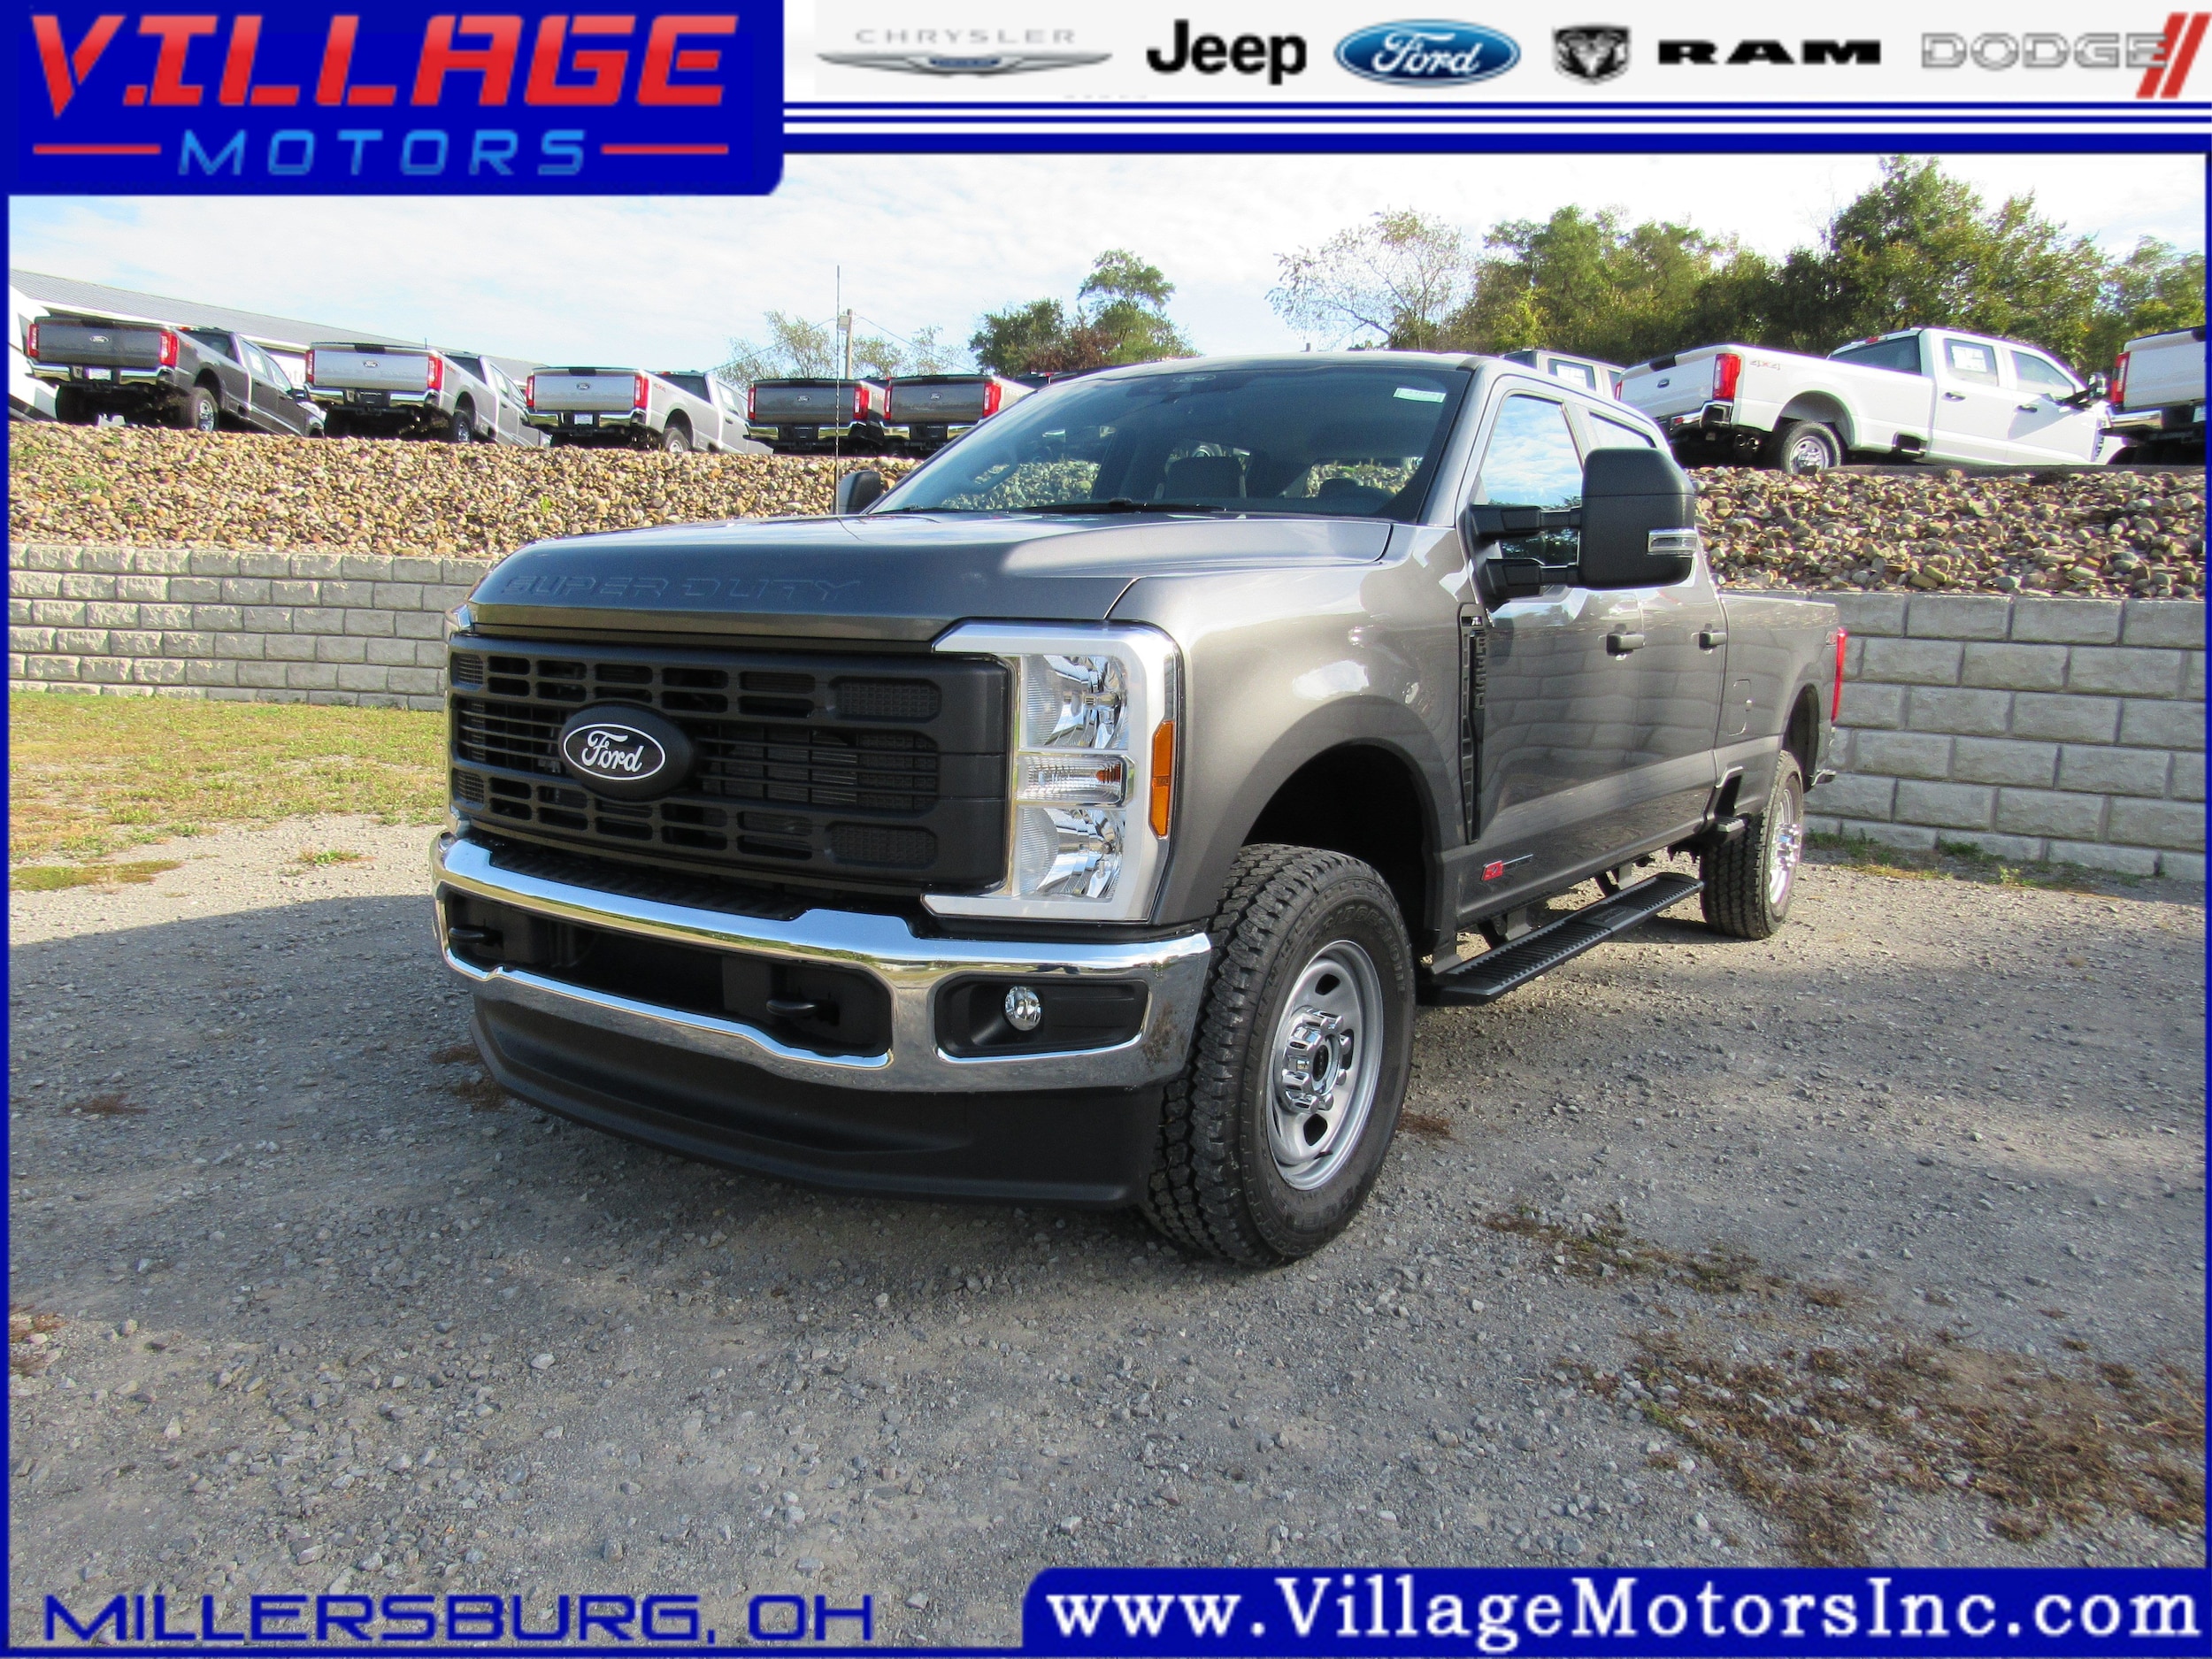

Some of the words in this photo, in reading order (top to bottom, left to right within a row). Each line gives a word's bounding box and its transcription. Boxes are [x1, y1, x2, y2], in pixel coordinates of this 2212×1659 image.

[502, 575, 670, 599] SUPER
[682, 578, 861, 602] DUTY
[581, 730, 644, 772] Ford
